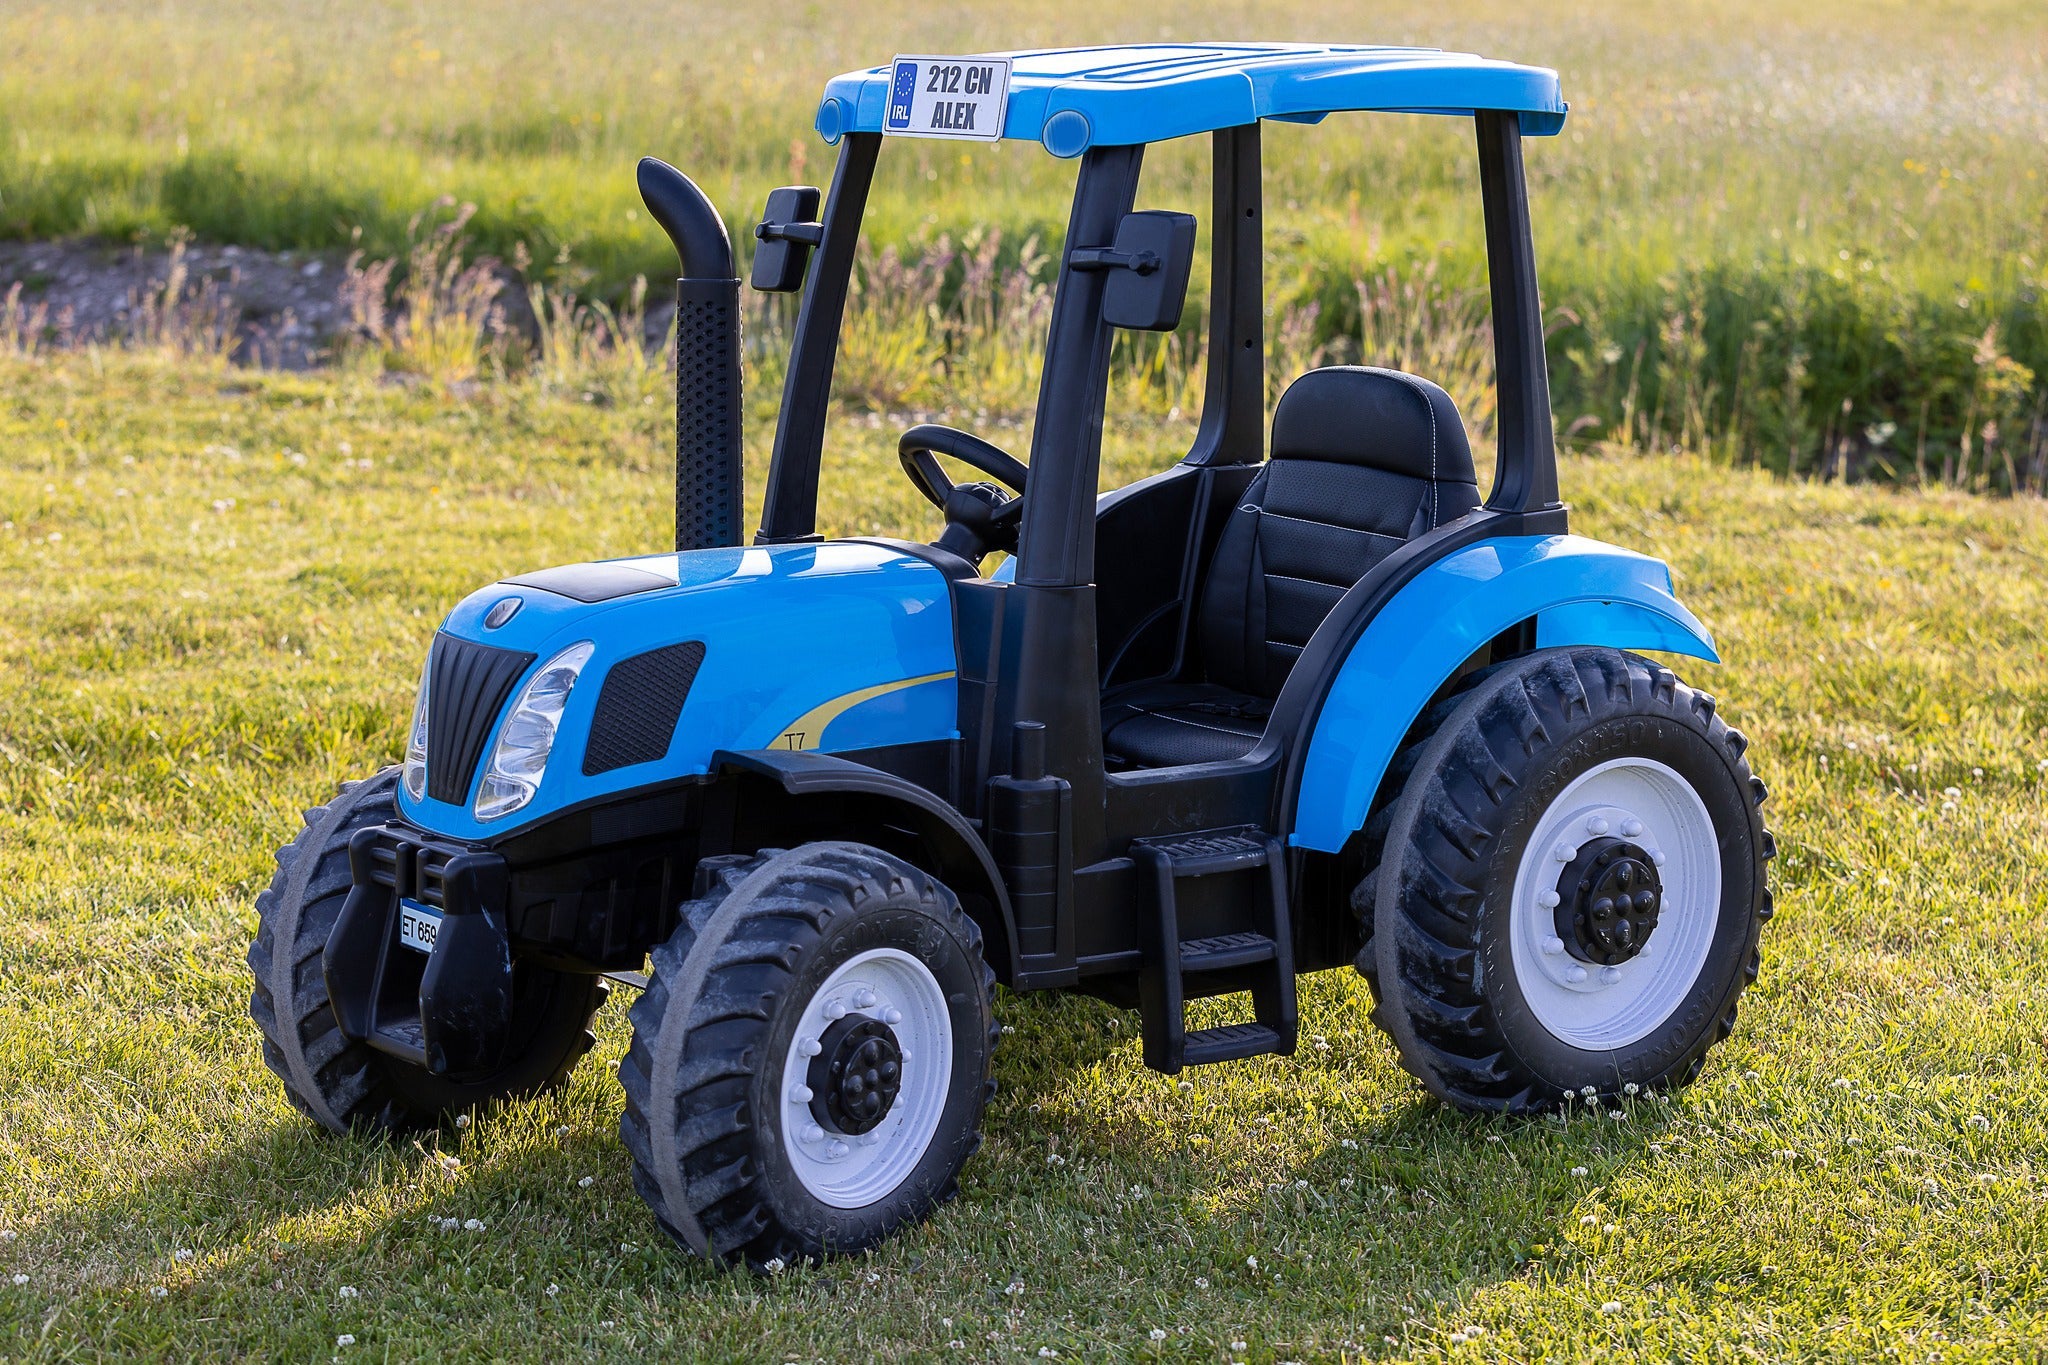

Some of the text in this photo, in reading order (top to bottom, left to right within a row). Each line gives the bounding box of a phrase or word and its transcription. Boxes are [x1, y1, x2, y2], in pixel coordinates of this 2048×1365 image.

[926, 65, 993, 94] 212 CN
[892, 104, 909, 120] IRL
[930, 101, 977, 129] ALEX
[784, 732, 806, 751] T7
[403, 914, 437, 946] ET 659
